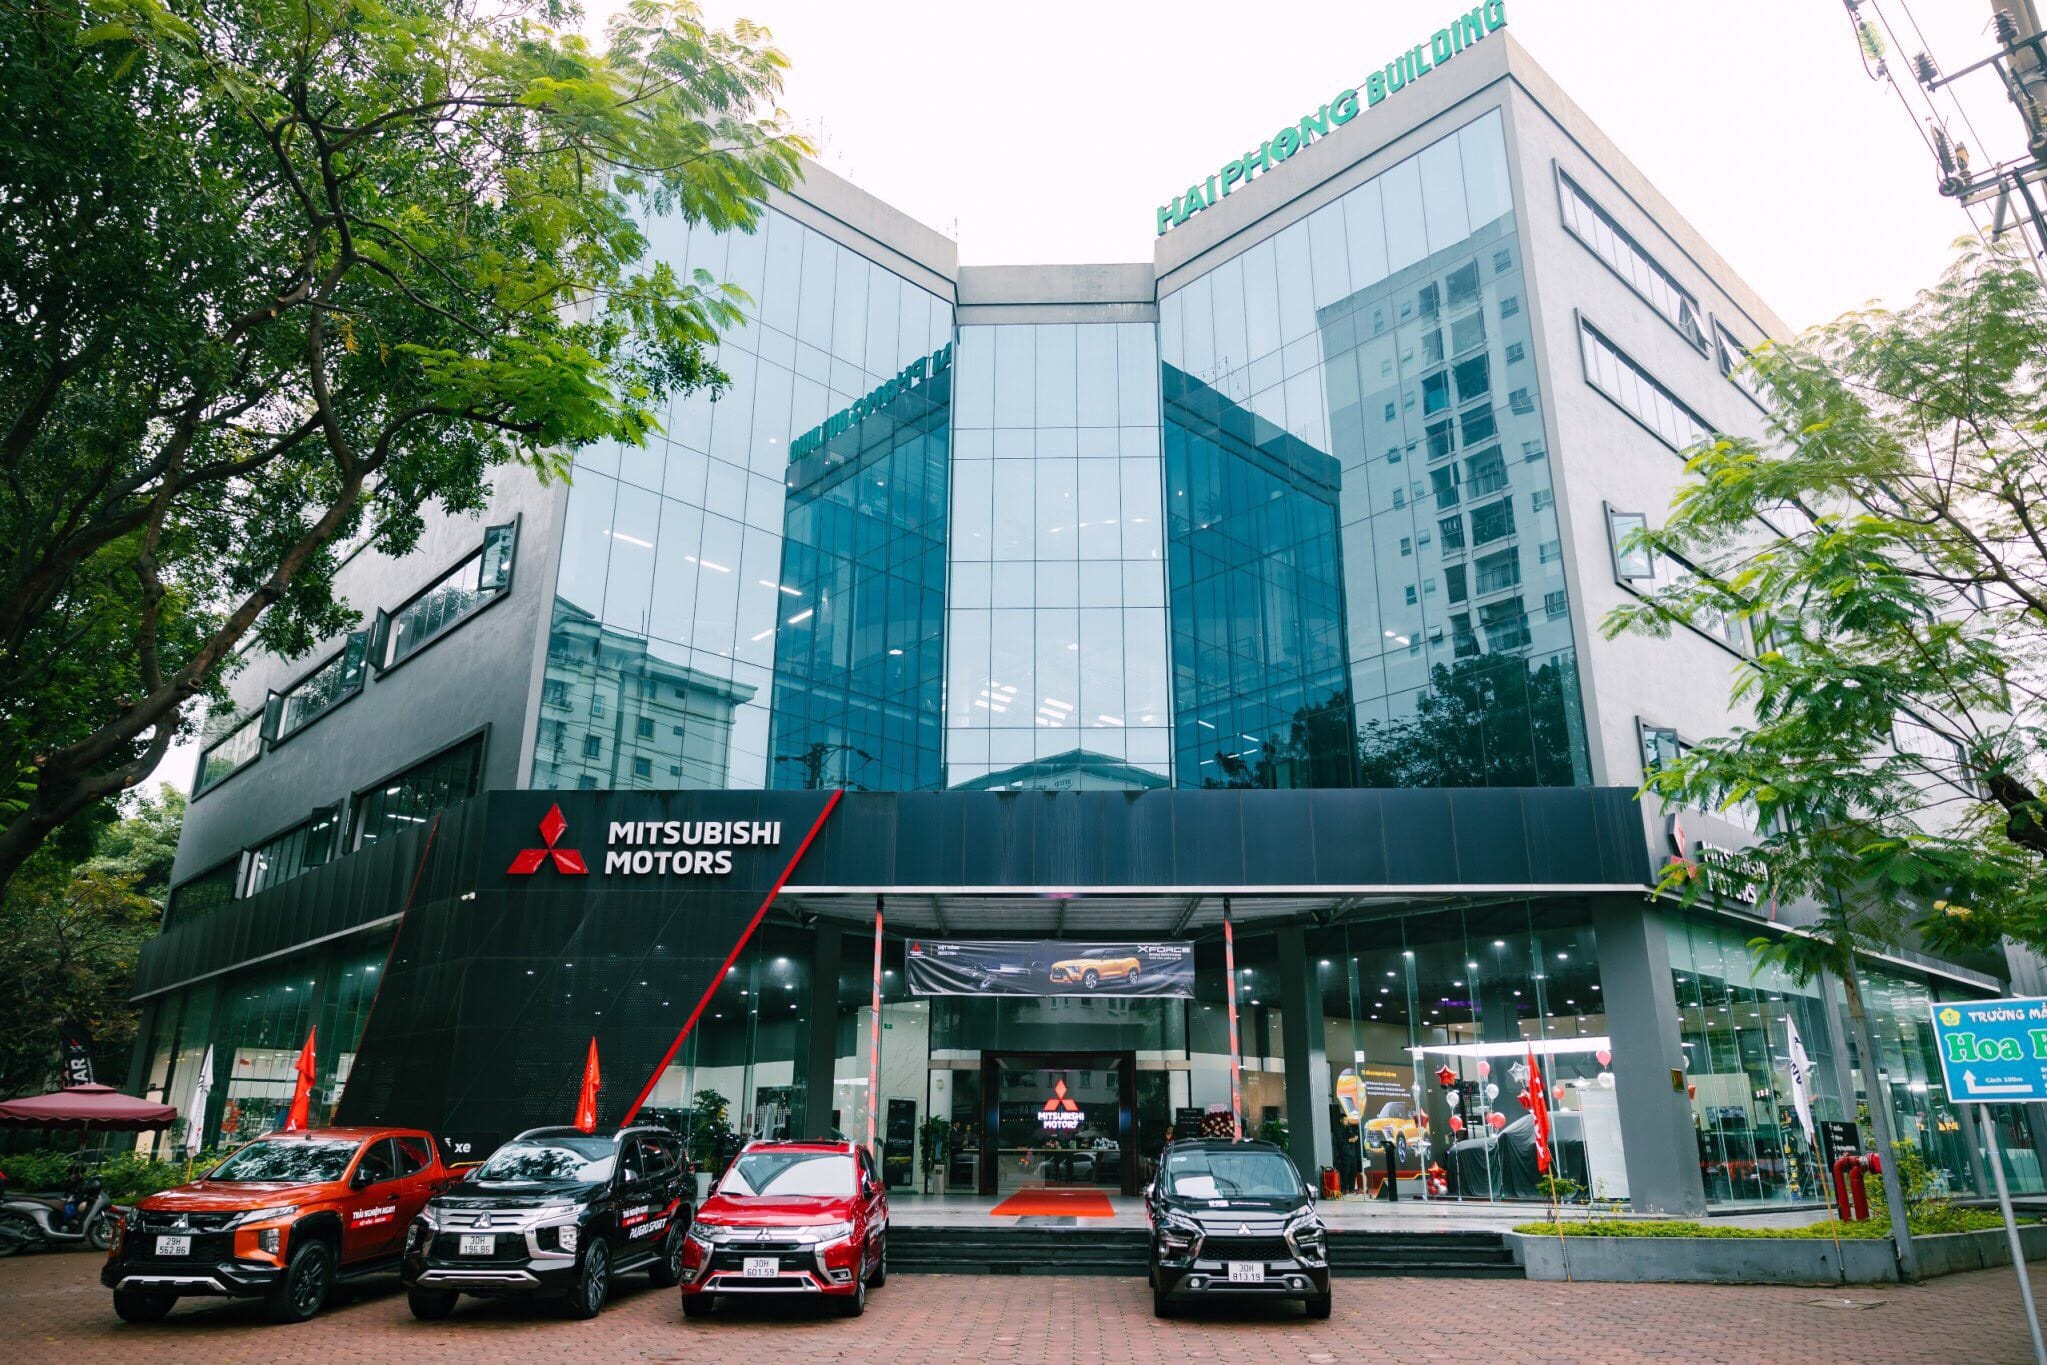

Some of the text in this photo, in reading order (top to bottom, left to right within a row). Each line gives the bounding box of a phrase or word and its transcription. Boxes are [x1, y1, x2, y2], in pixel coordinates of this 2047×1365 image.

[1156, 0, 1507, 236] HAI PHONG BUILDING
[608, 821, 781, 845] MITSUBISHI
[604, 850, 732, 875] MOTORS
[1968, 1007, 2025, 1023] TRƯỜNG
[1944, 1032, 2024, 1062] Hoa
[1038, 1112, 1084, 1120] MITSUBISHI
[1043, 1120, 1079, 1128] MOTORS
[454, 1142, 471, 1153] xe
[754, 1259, 769, 1267] 30H
[1239, 1264, 1254, 1272] 30H
